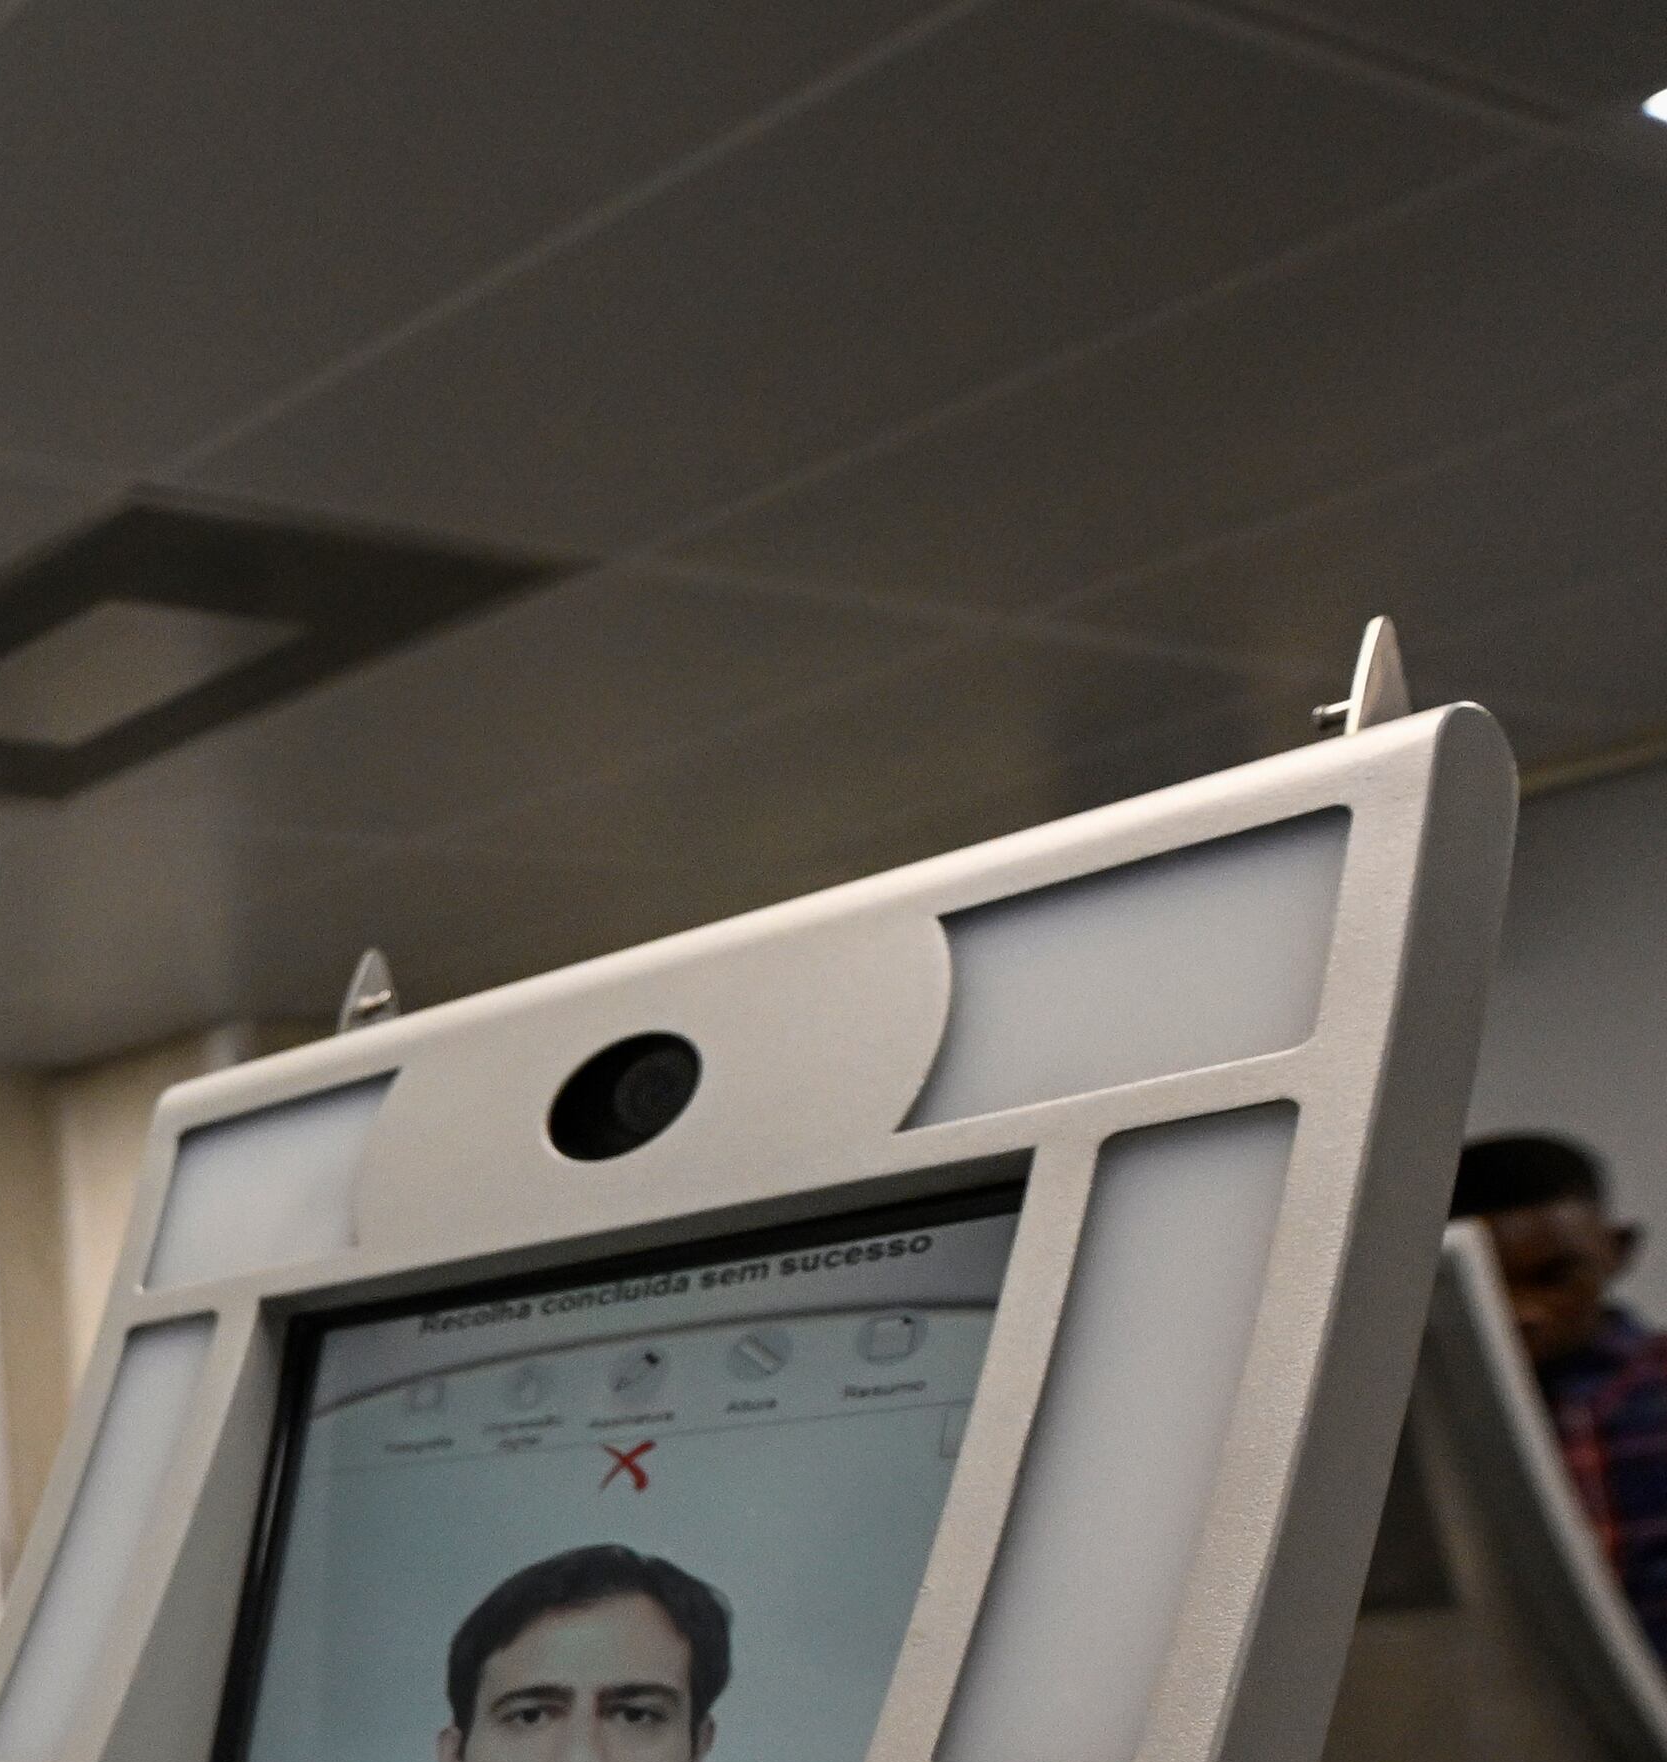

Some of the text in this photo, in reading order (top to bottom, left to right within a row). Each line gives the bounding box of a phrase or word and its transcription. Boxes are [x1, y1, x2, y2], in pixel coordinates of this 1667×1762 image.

[419, 1299, 532, 1334] Recolha
[699, 1261, 770, 1290] sem
[779, 1234, 933, 1277] sucesso
